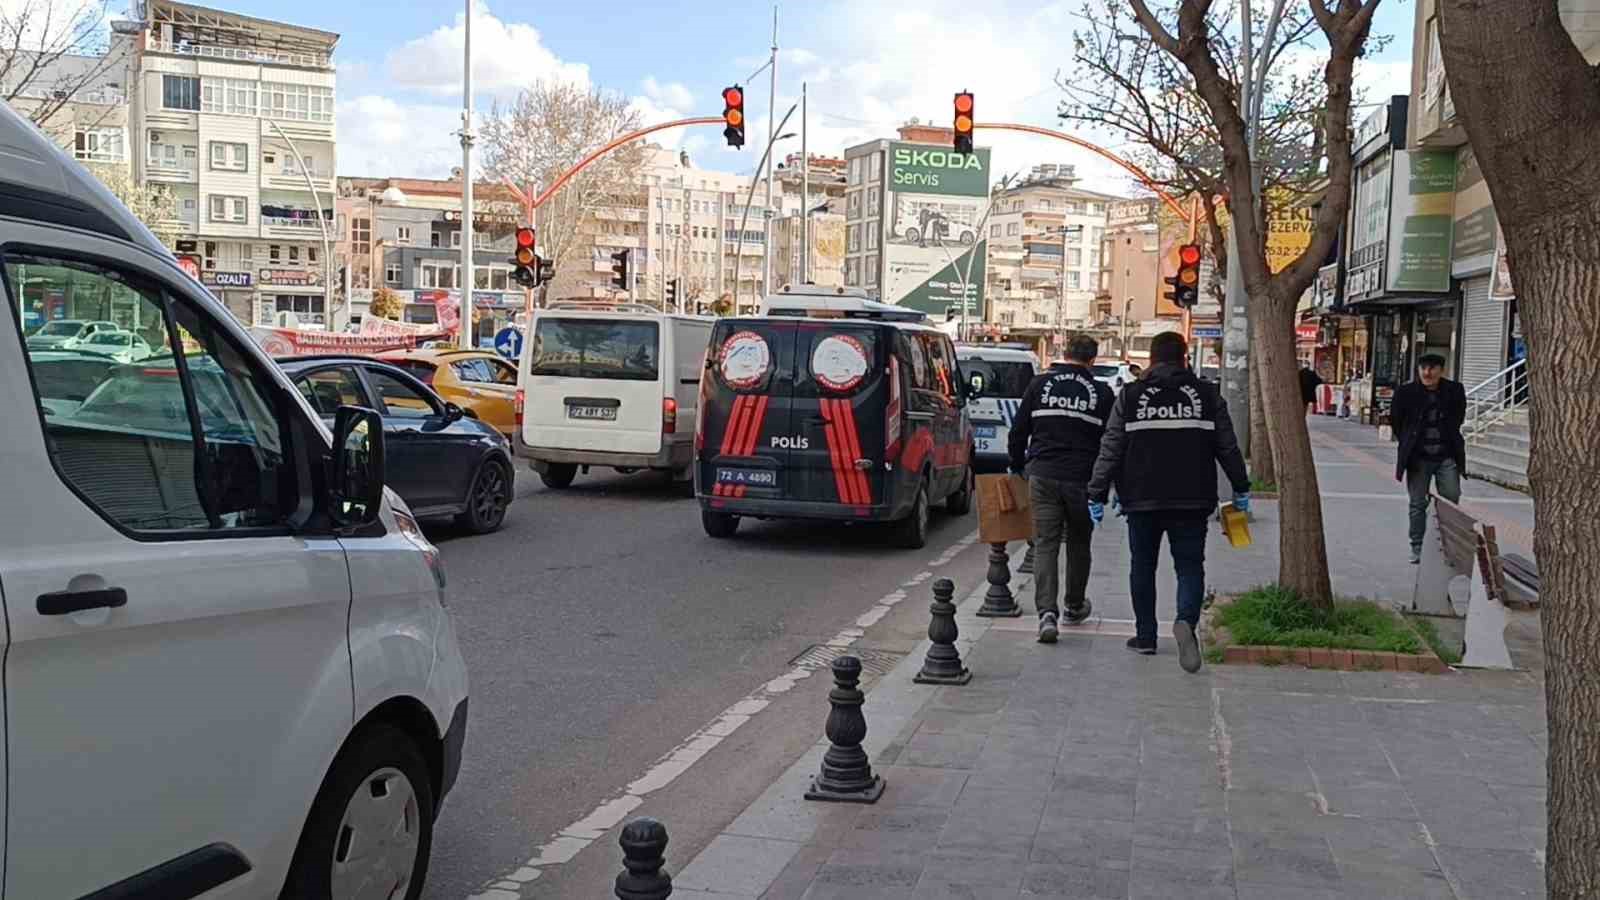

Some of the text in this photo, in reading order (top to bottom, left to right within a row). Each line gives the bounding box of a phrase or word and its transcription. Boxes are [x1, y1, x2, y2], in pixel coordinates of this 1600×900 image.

[894, 168, 939, 186] Servis
[1048, 395, 1088, 411] POLİS
[1147, 402, 1193, 419] POLİS
[770, 435, 809, 449] POLİS
[720, 471, 732, 480] 72
[736, 472, 745, 481] A
